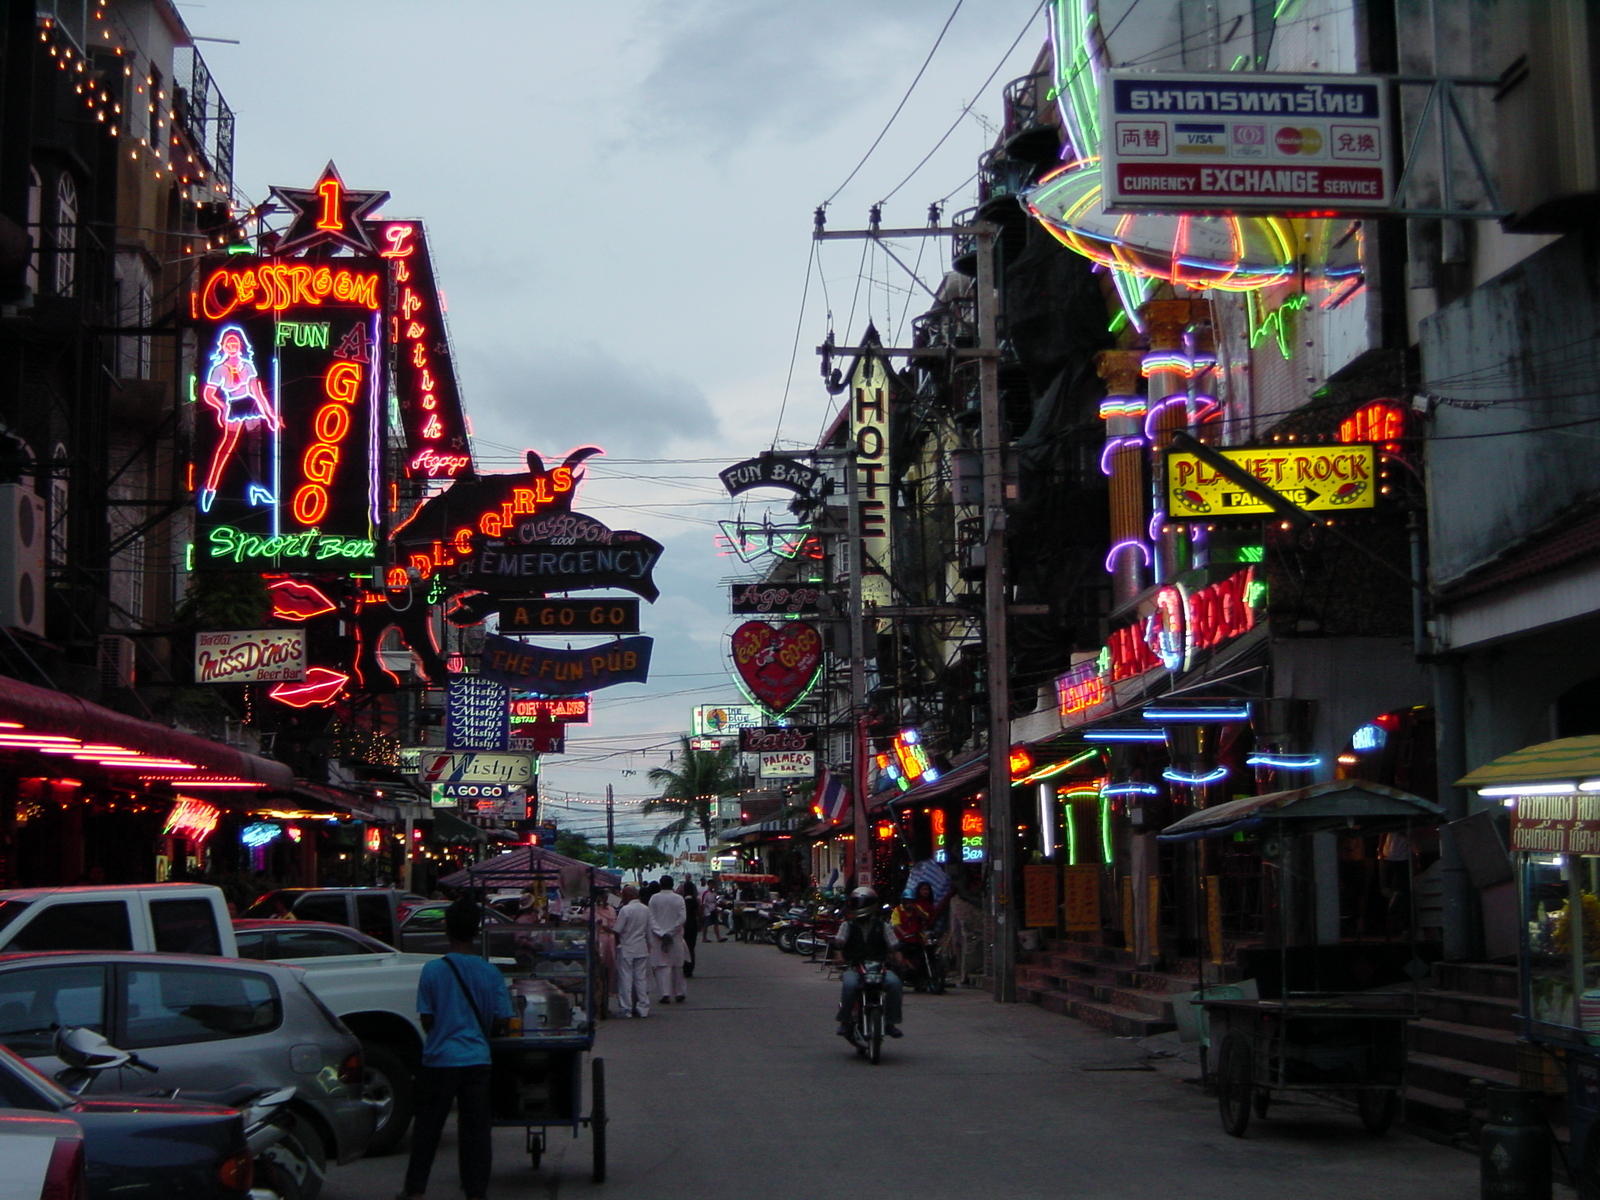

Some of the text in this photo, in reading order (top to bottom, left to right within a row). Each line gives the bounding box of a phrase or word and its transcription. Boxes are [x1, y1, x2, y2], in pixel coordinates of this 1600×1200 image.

[1187, 134, 1214, 145] VISA
[1123, 168, 1377, 195] CURRENCY EXCHANGE SERVICE
[317, 180, 343, 230] 1
[275, 321, 330, 350] FUN
[724, 462, 813, 489] FUN BAR
[1294, 453, 1369, 483] ROCK
[855, 386, 887, 577] HOTEL
[480, 467, 573, 537] GIRLS
[209, 526, 377, 563] Sport Bar
[550, 536, 577, 546] 2000
[479, 548, 654, 579] EMERGENCY
[514, 607, 625, 626] A GO GO
[256, 666, 303, 681] Beer Bar
[489, 652, 530, 677] THE
[538, 660, 583, 681] FUN
[590, 651, 637, 673] PUB
[450, 685, 507, 698] Misty's
[450, 695, 506, 709] Misty's
[451, 706, 504, 719] Misty's
[452, 716, 503, 729] Misty's
[453, 726, 502, 739] Misty's
[453, 737, 501, 750] Misty's
[424, 754, 529, 783] Misty's
[763, 753, 812, 767] PALMER'S
[446, 785, 457, 796] A
[457, 784, 479, 797] GO
[481, 785, 503, 798] GO
